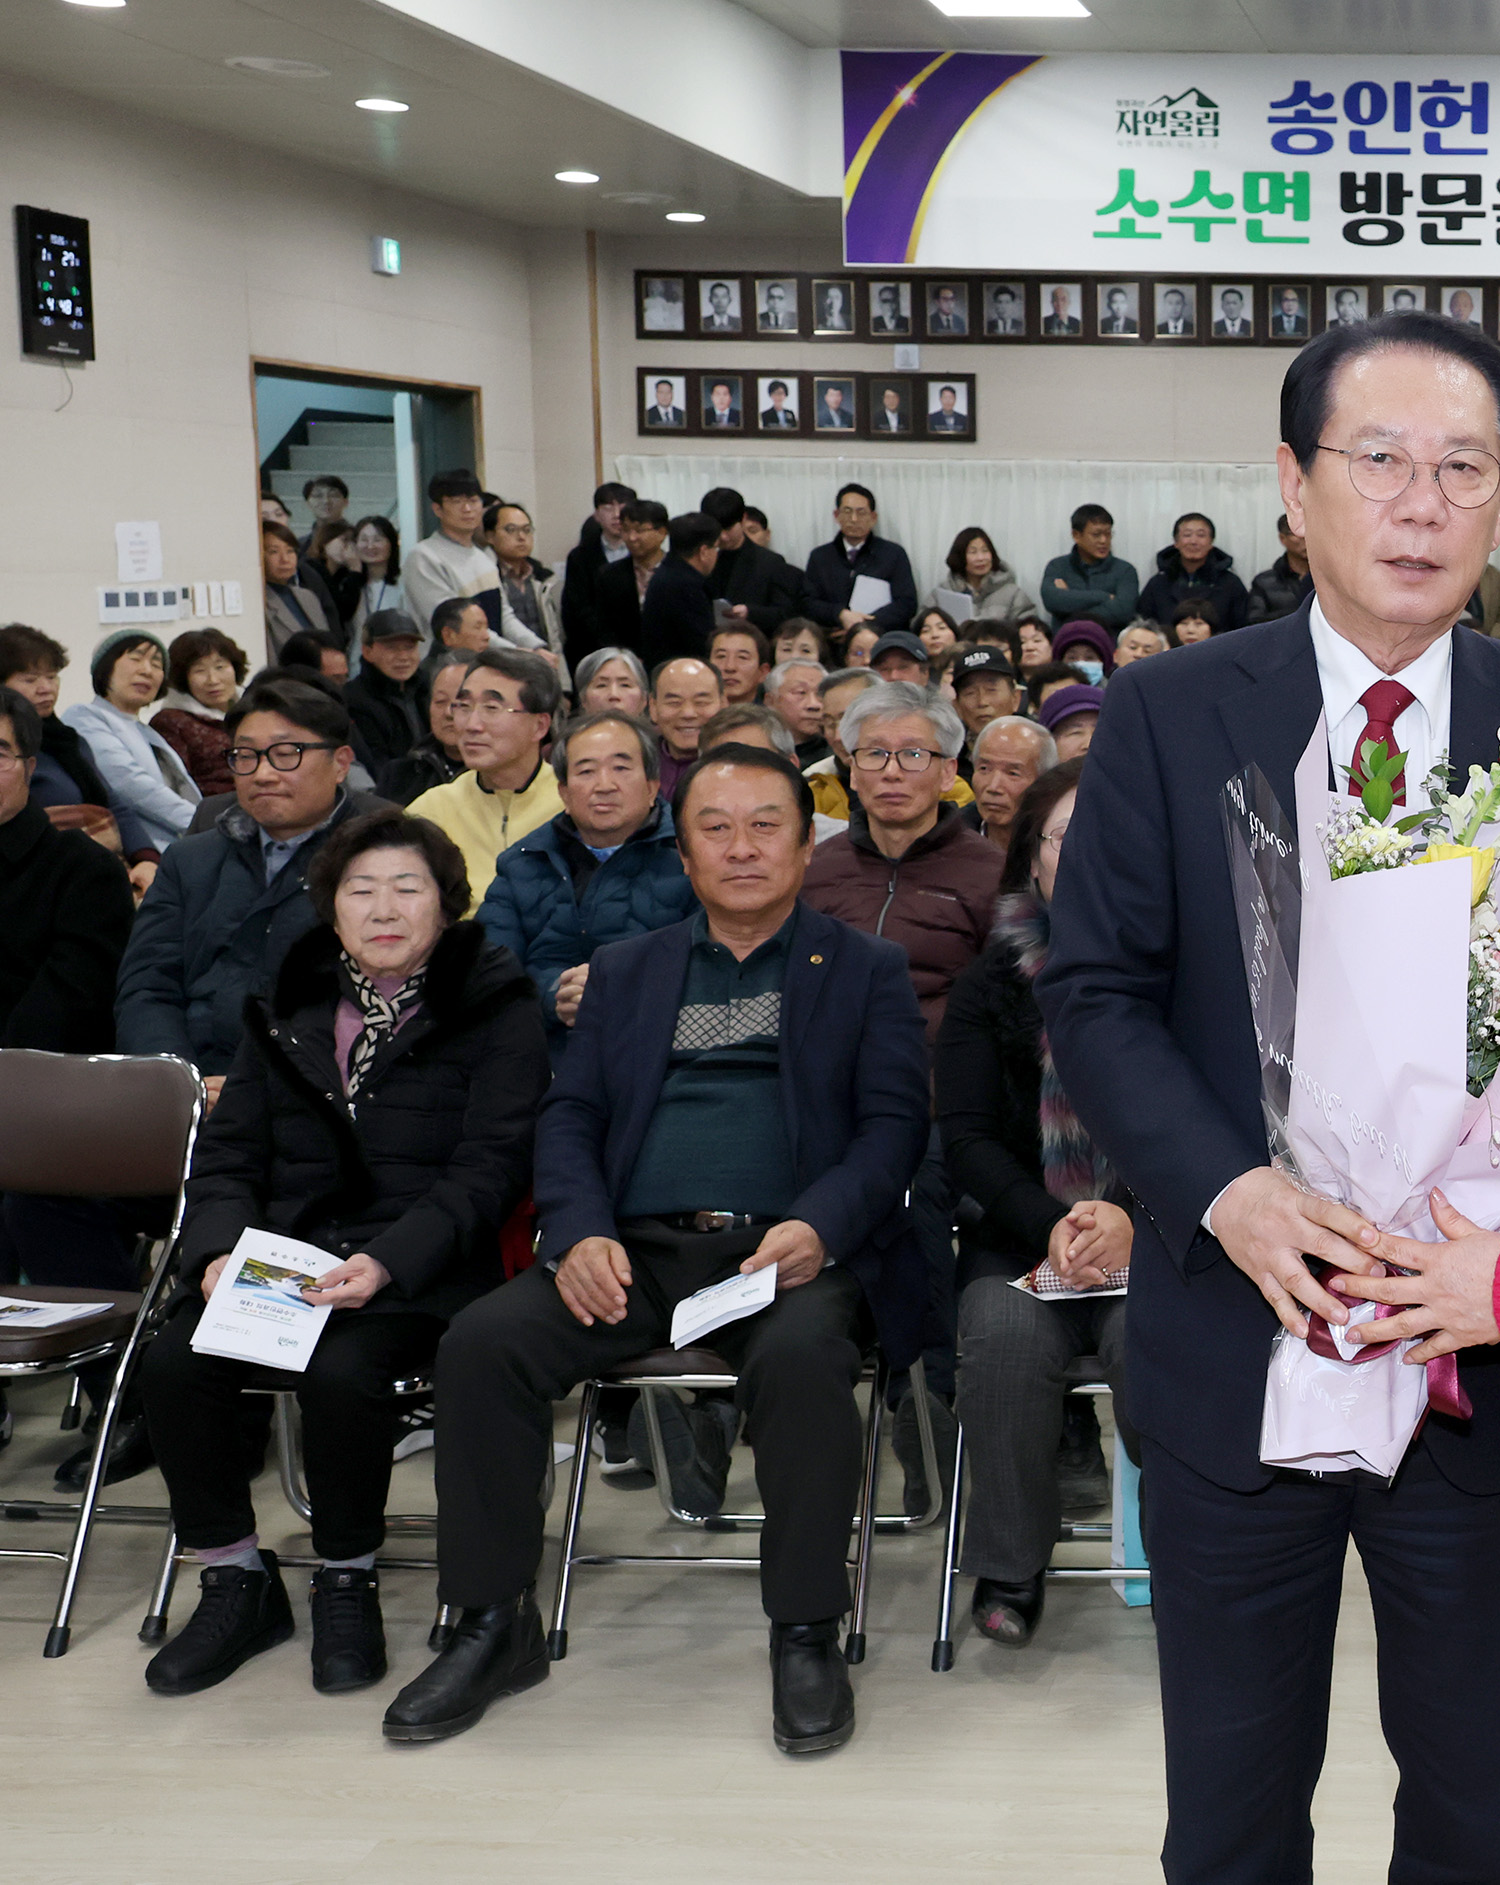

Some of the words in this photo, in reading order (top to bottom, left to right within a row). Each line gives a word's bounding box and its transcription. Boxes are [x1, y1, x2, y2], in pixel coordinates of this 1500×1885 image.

[1116, 109, 1219, 137] 자연울림
[1267, 79, 1489, 155] 송인헌
[1093, 168, 1310, 244] 소수면
